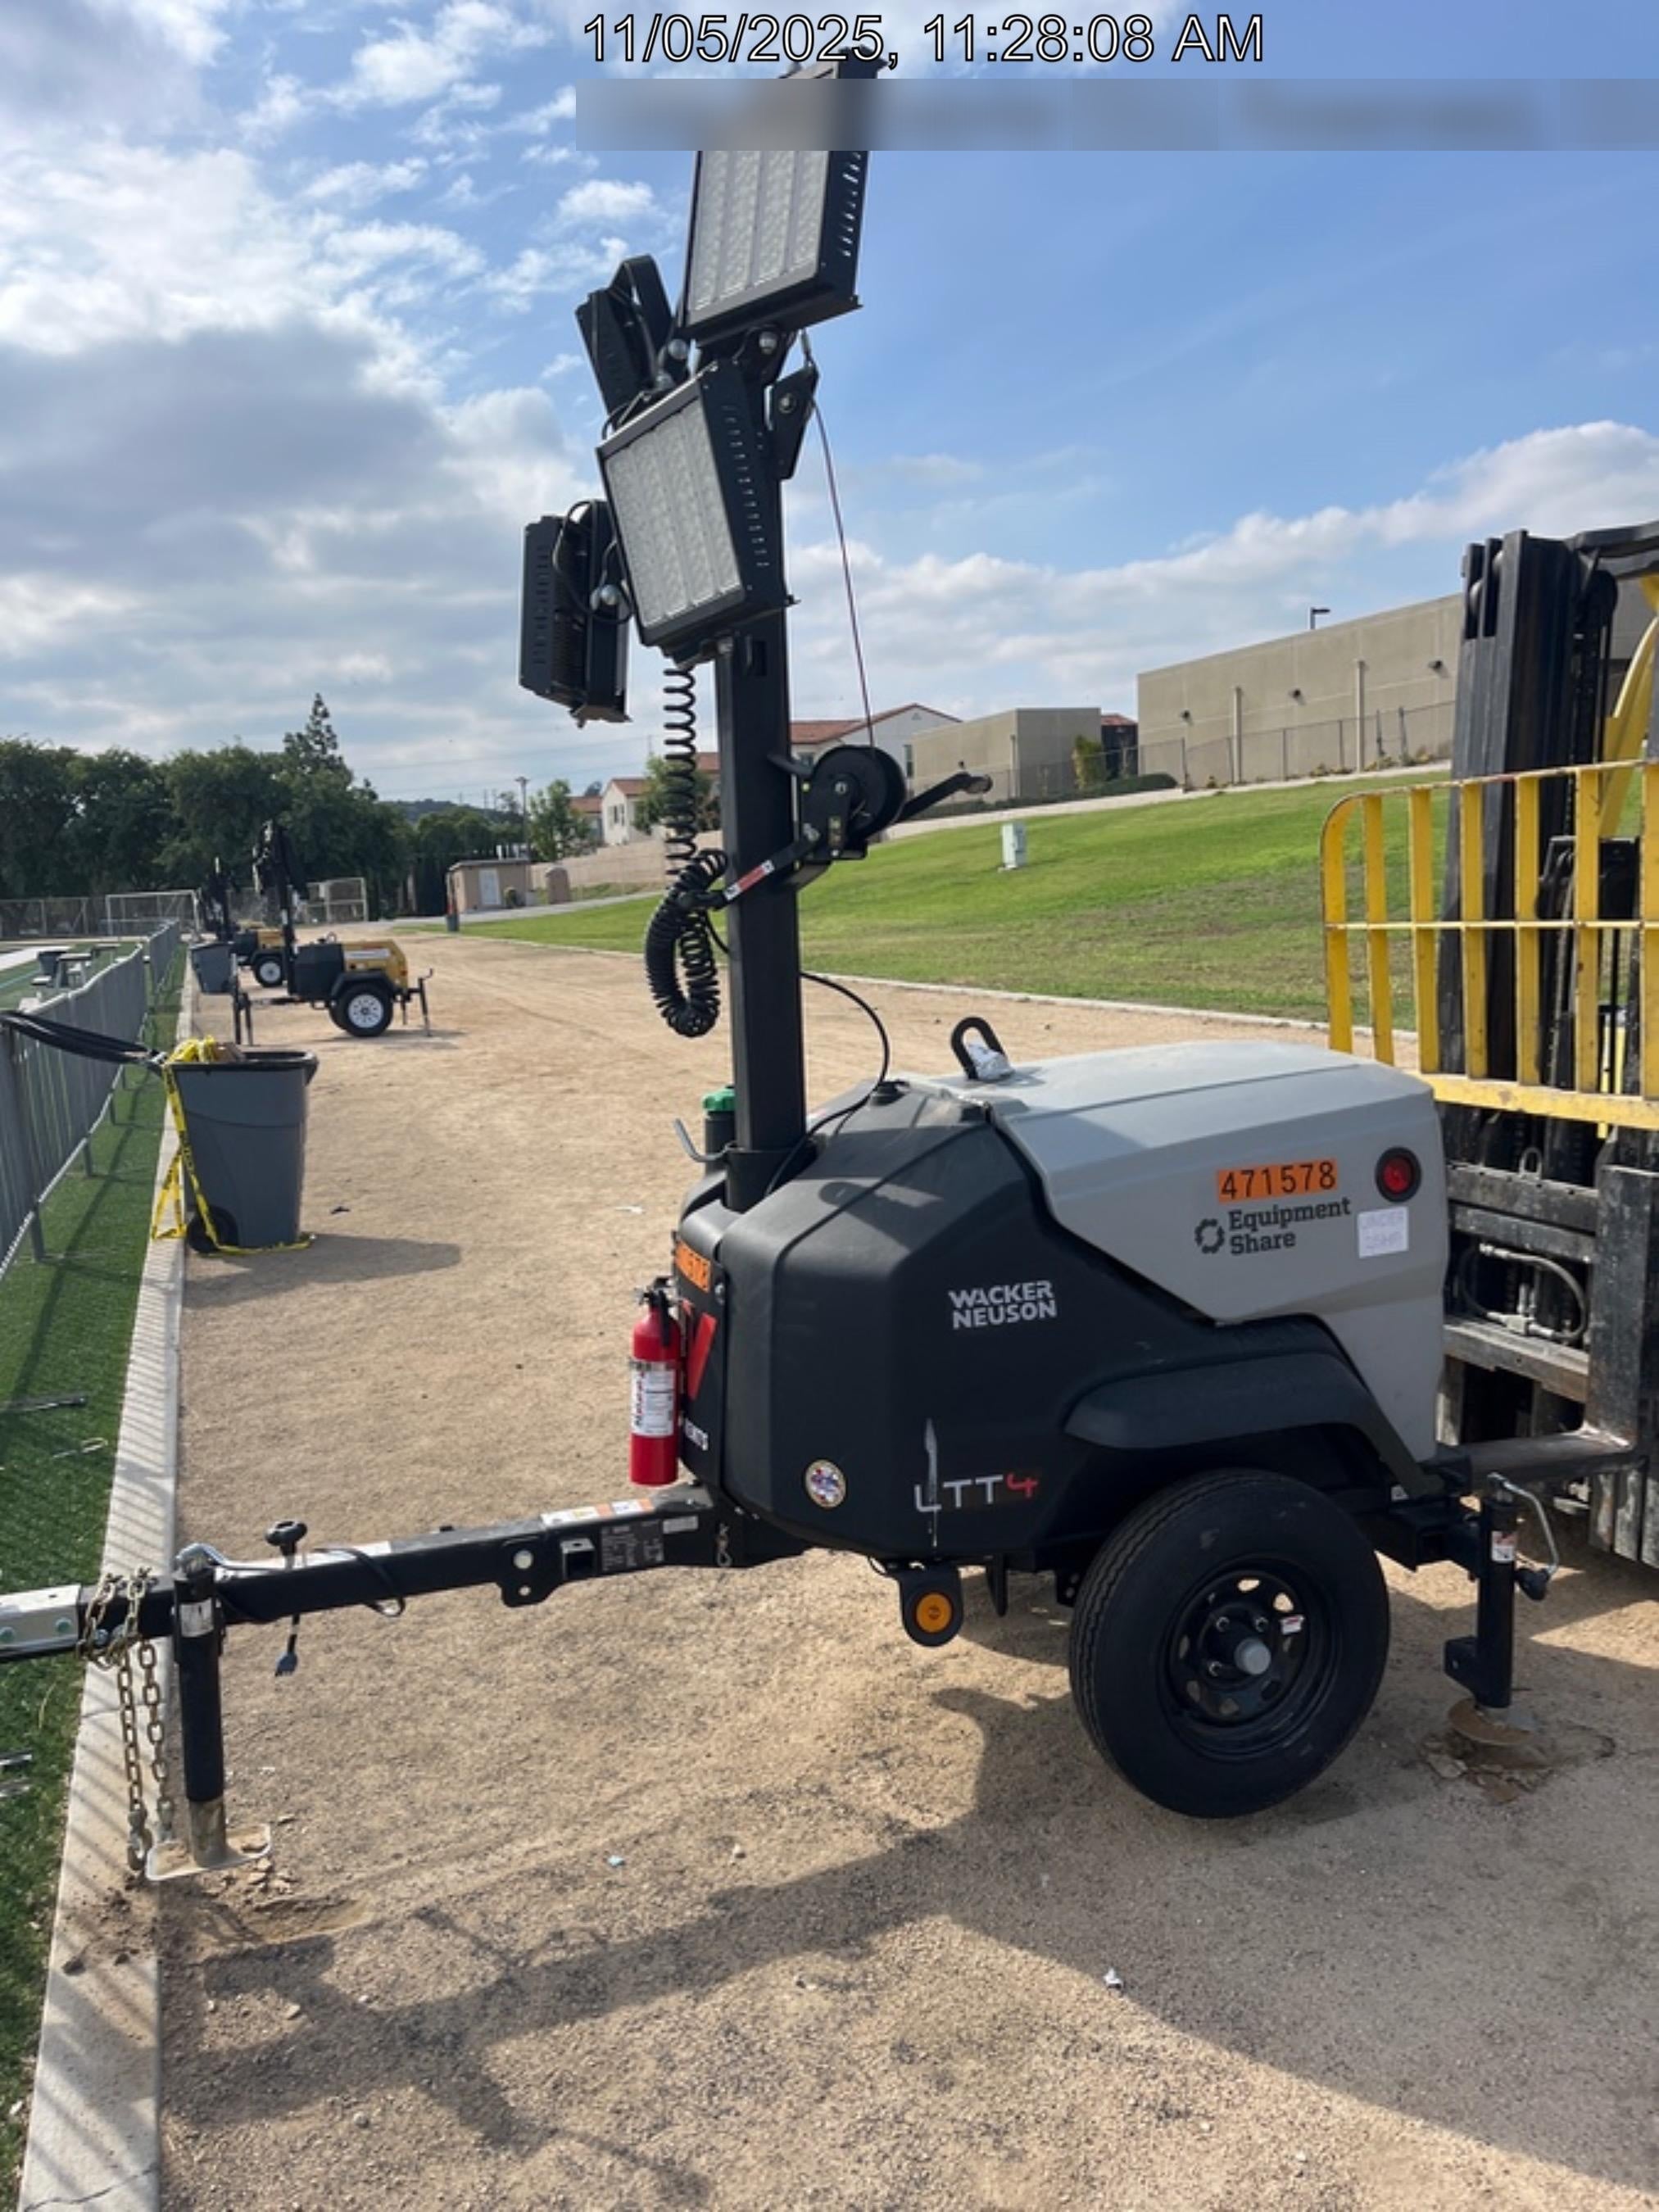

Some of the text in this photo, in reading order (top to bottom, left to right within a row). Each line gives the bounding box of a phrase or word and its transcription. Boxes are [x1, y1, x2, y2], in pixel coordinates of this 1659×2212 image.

[1220, 1160, 1337, 1199] 471578
[1229, 1197, 1351, 1231] Equipment
[1231, 1231, 1296, 1256] Share
[948, 1280, 1054, 1309] WACKER
[953, 1299, 1058, 1330] NEUSON
